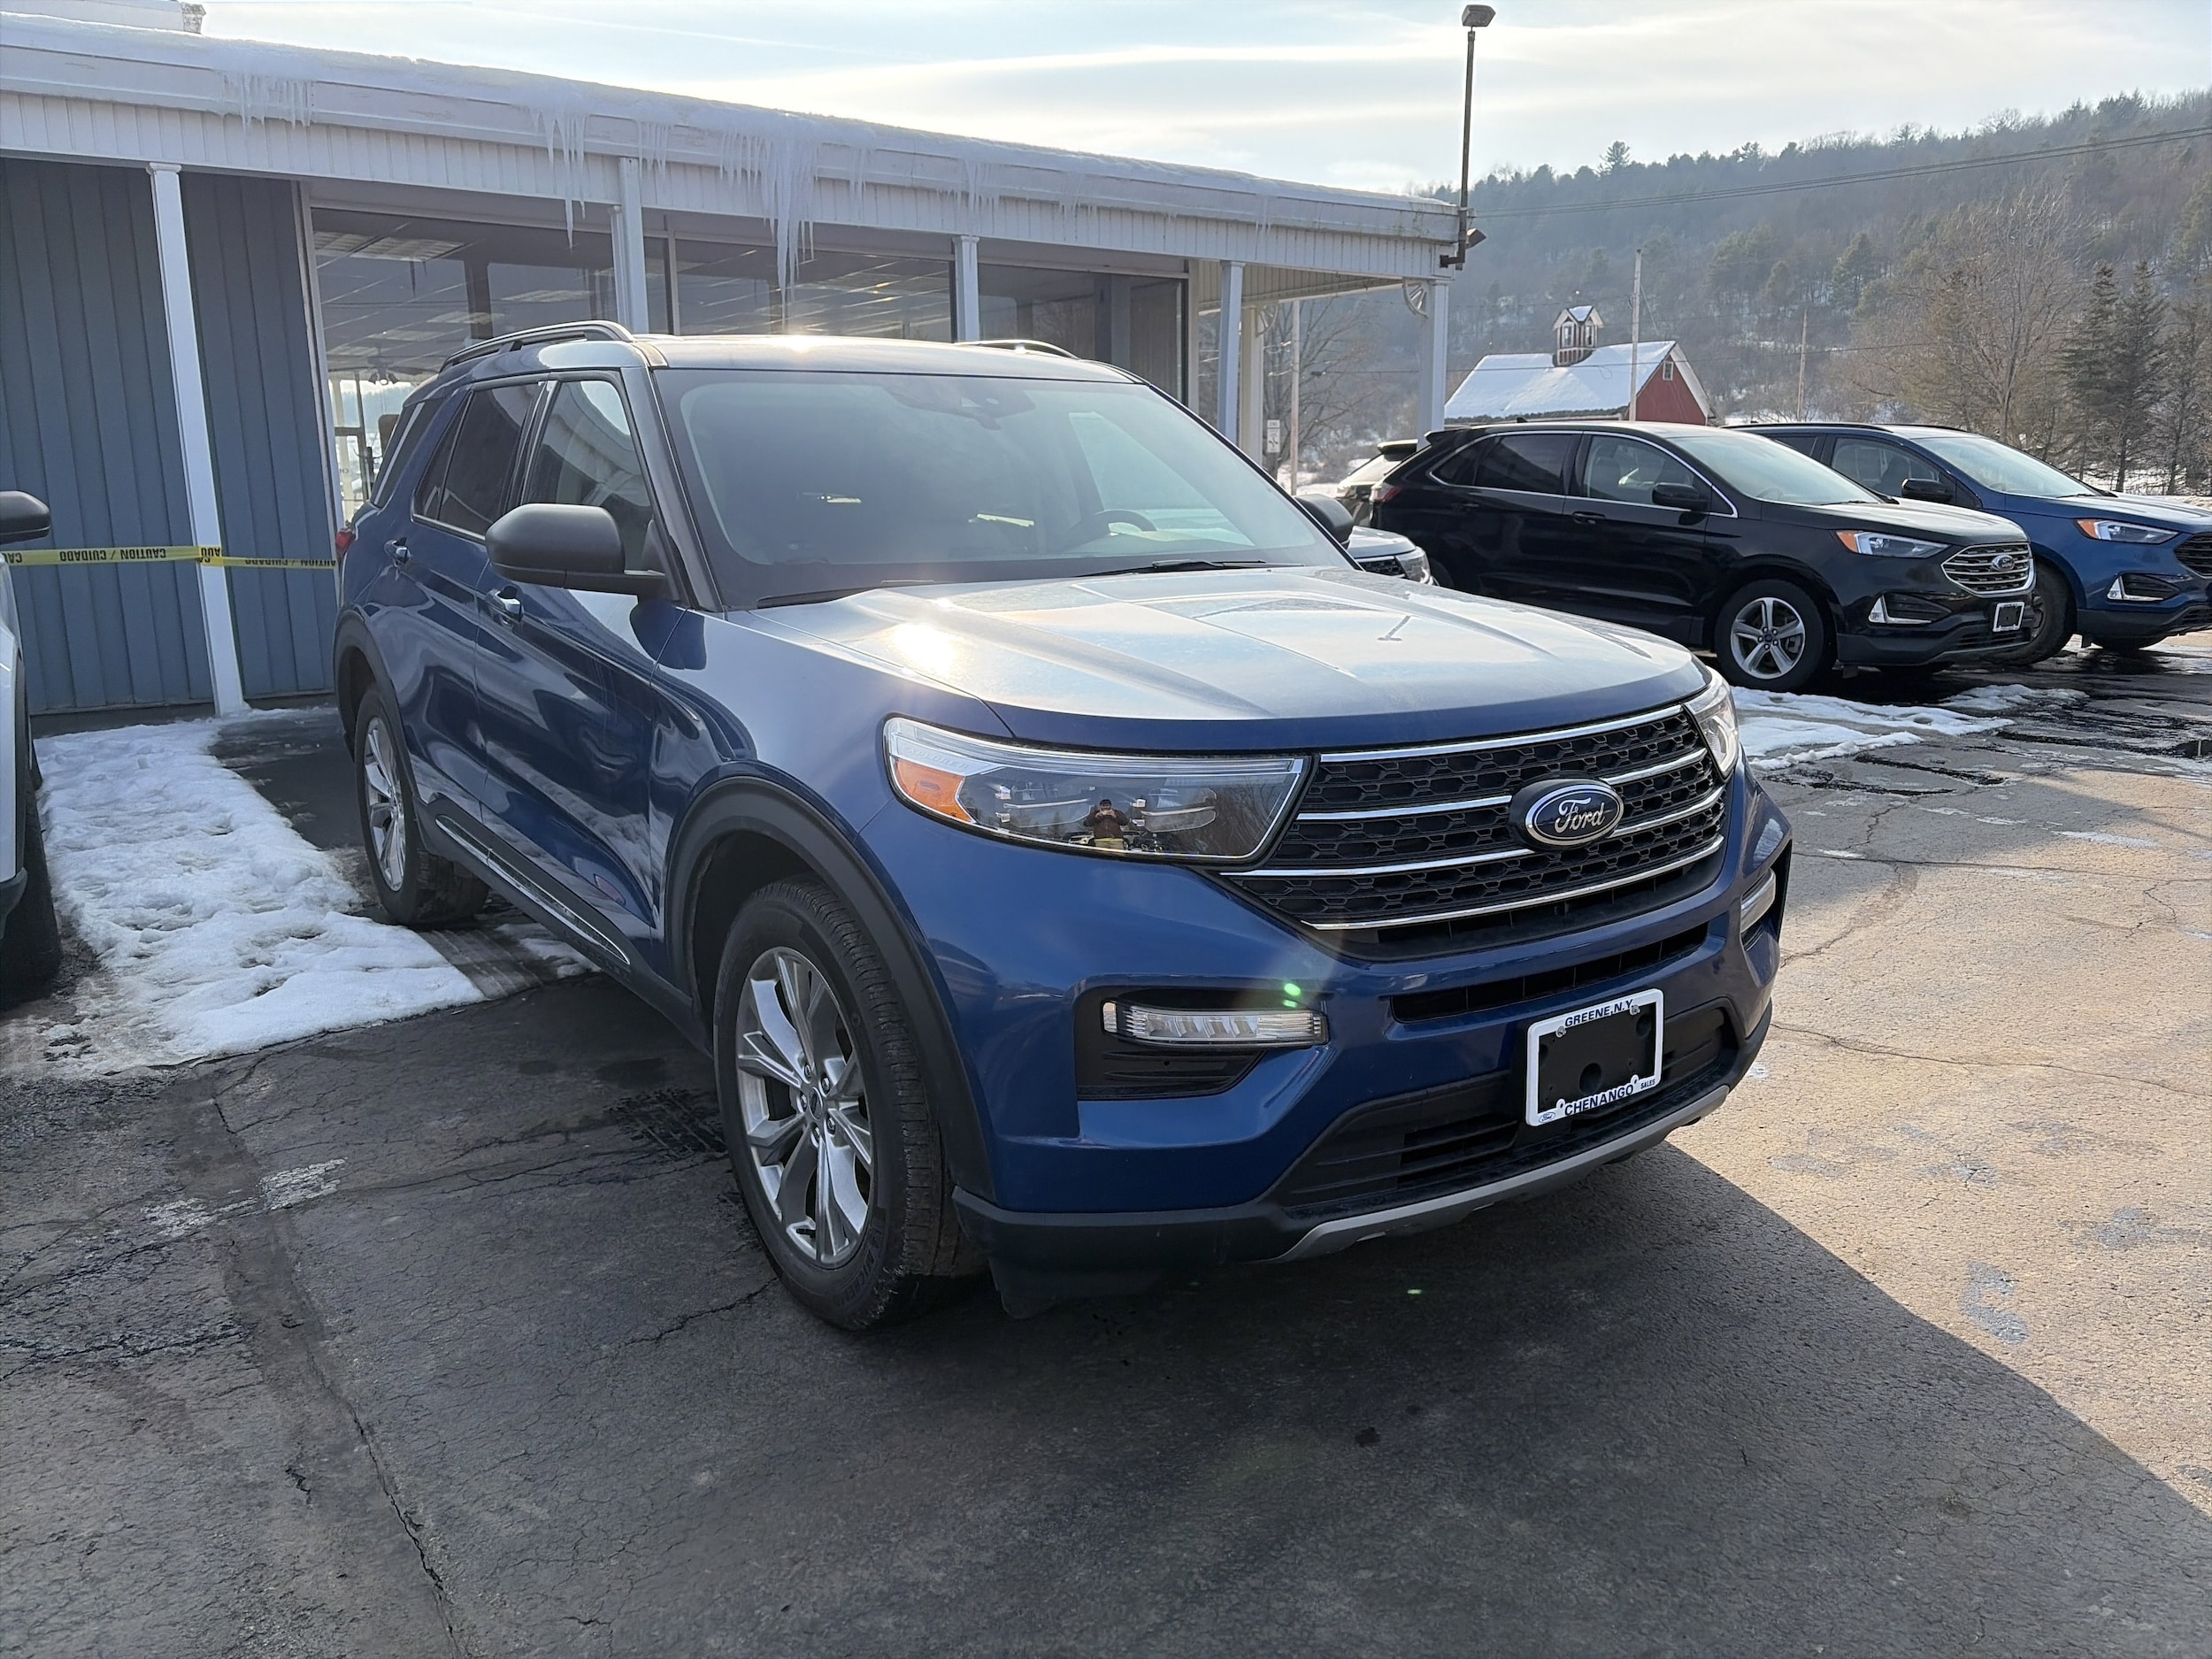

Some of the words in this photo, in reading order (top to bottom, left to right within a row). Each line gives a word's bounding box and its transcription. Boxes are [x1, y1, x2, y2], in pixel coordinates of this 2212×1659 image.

[59, 550, 106, 562] CUIDADO
[120, 549, 166, 560] CAUTION
[1555, 797, 1606, 833] Ford
[1564, 1085, 1633, 1116] CHENANGO
[1640, 1079, 1655, 1089] SALES
